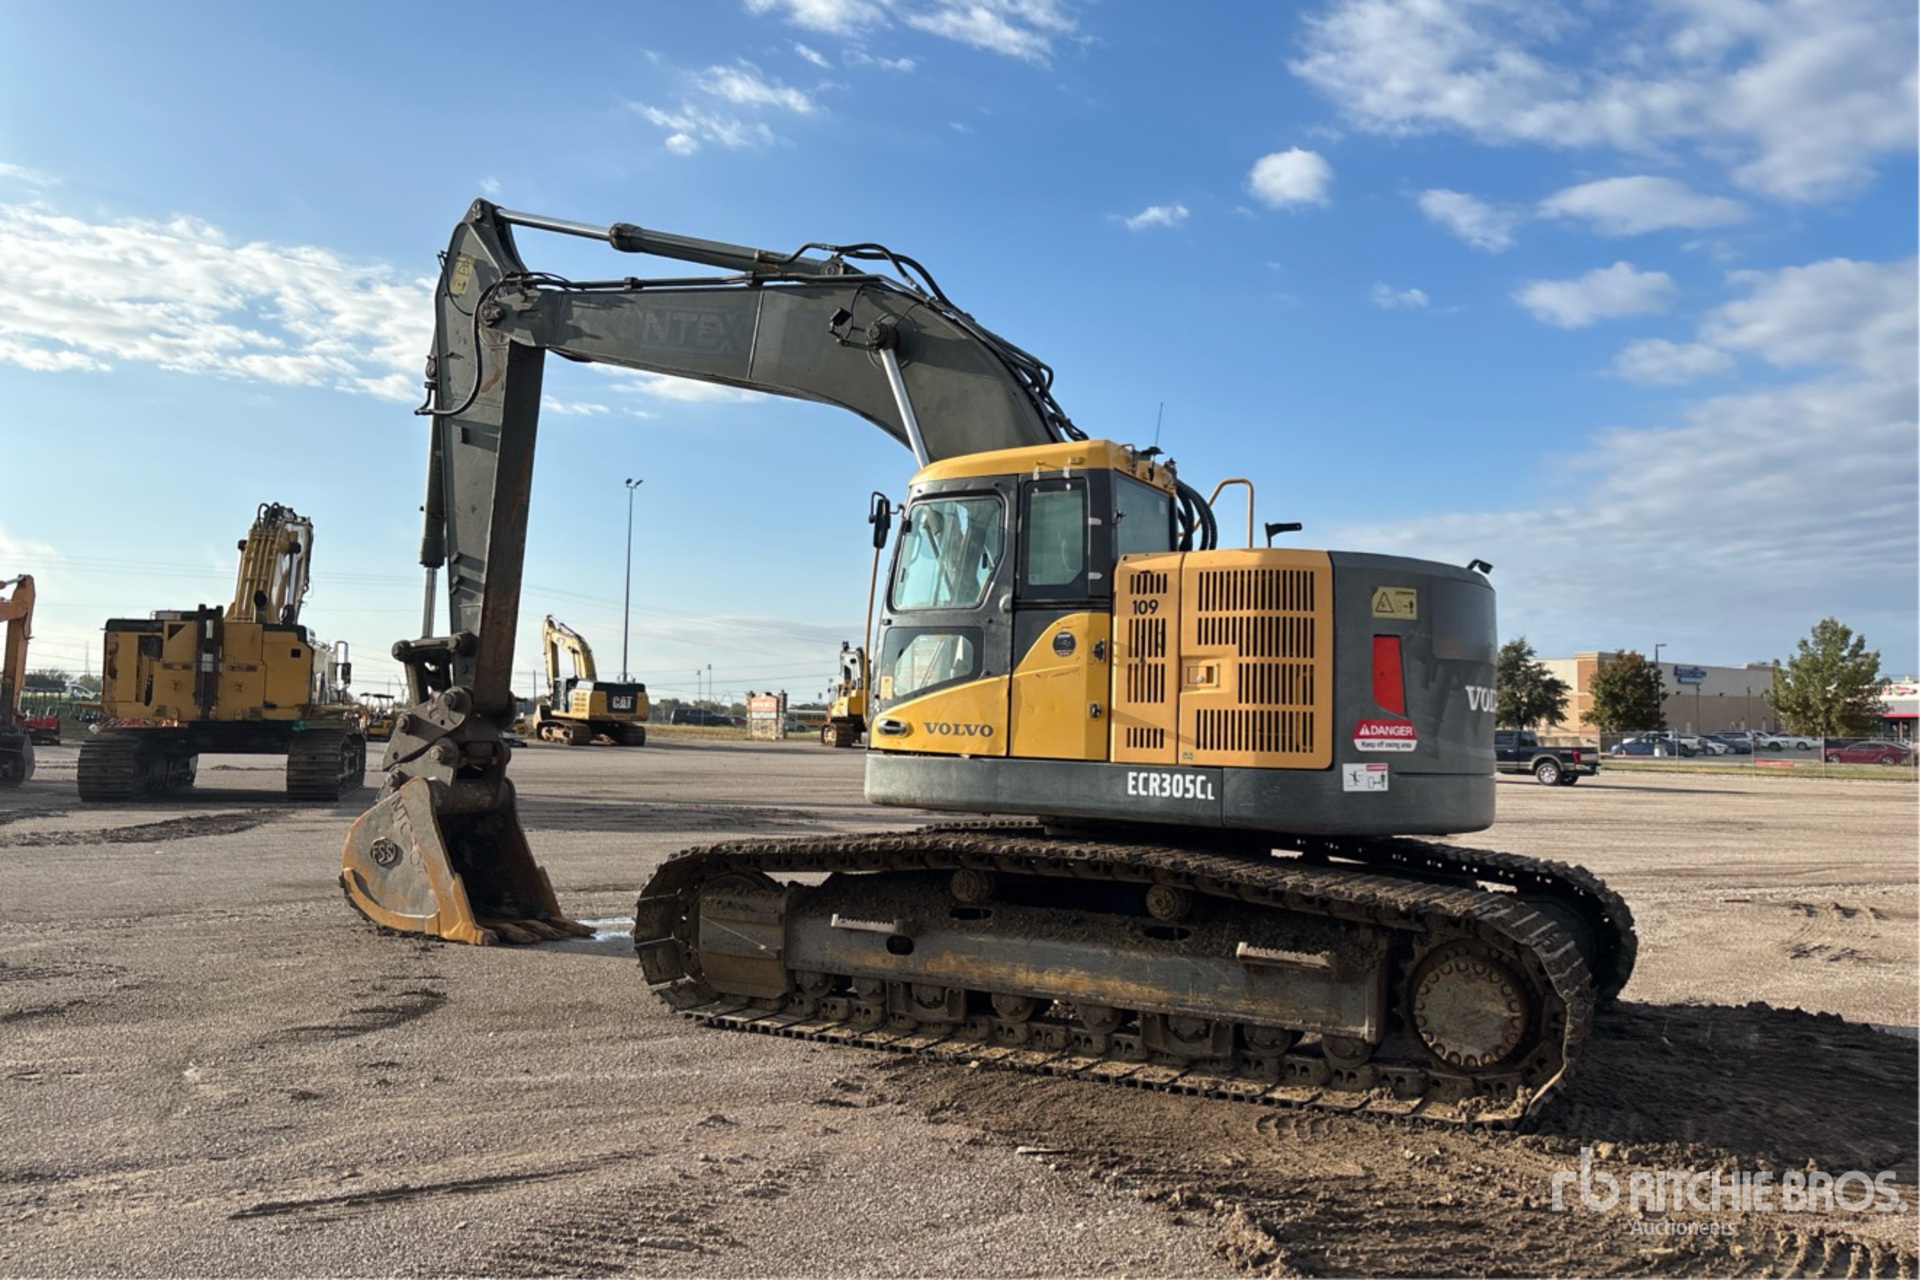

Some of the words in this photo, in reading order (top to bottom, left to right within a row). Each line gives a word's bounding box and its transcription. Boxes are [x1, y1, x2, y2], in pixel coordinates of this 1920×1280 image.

[1132, 598, 1159, 615] 109
[612, 696, 632, 709] CAT
[923, 721, 994, 737] VOLVO
[1370, 725, 1413, 736] DANGER
[1361, 741, 1376, 749] Keep
